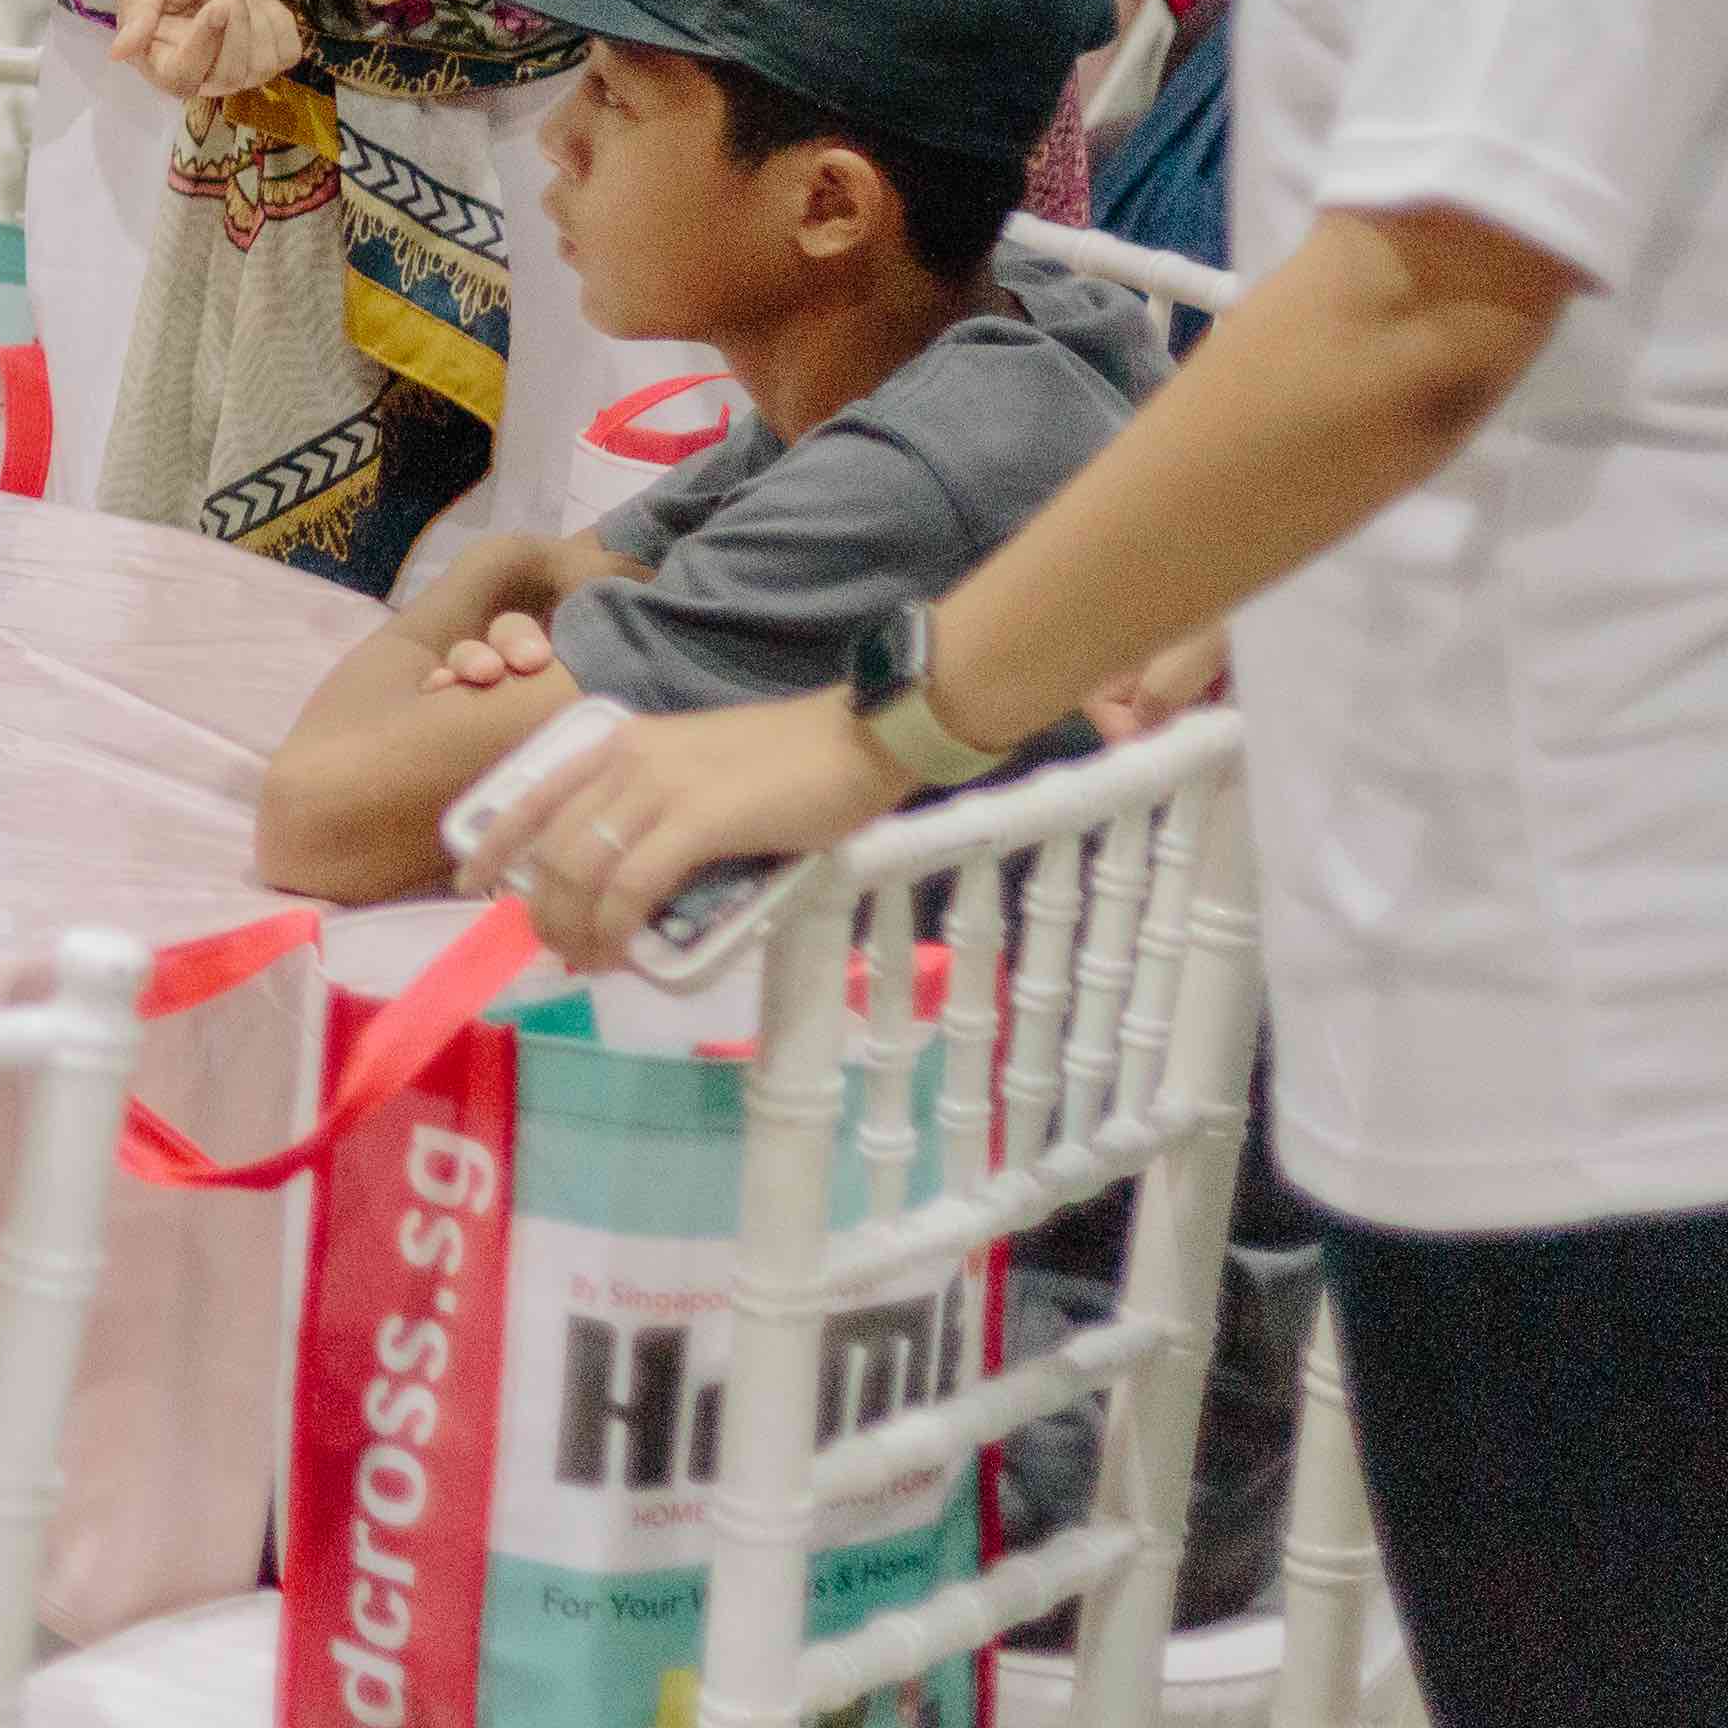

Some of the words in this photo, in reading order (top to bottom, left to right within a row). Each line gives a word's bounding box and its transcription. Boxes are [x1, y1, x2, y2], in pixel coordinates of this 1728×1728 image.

[609, 1280, 731, 1314] Singapo
[330, 1123, 496, 1728] dcross.sg
[542, 1584, 598, 1620] For
